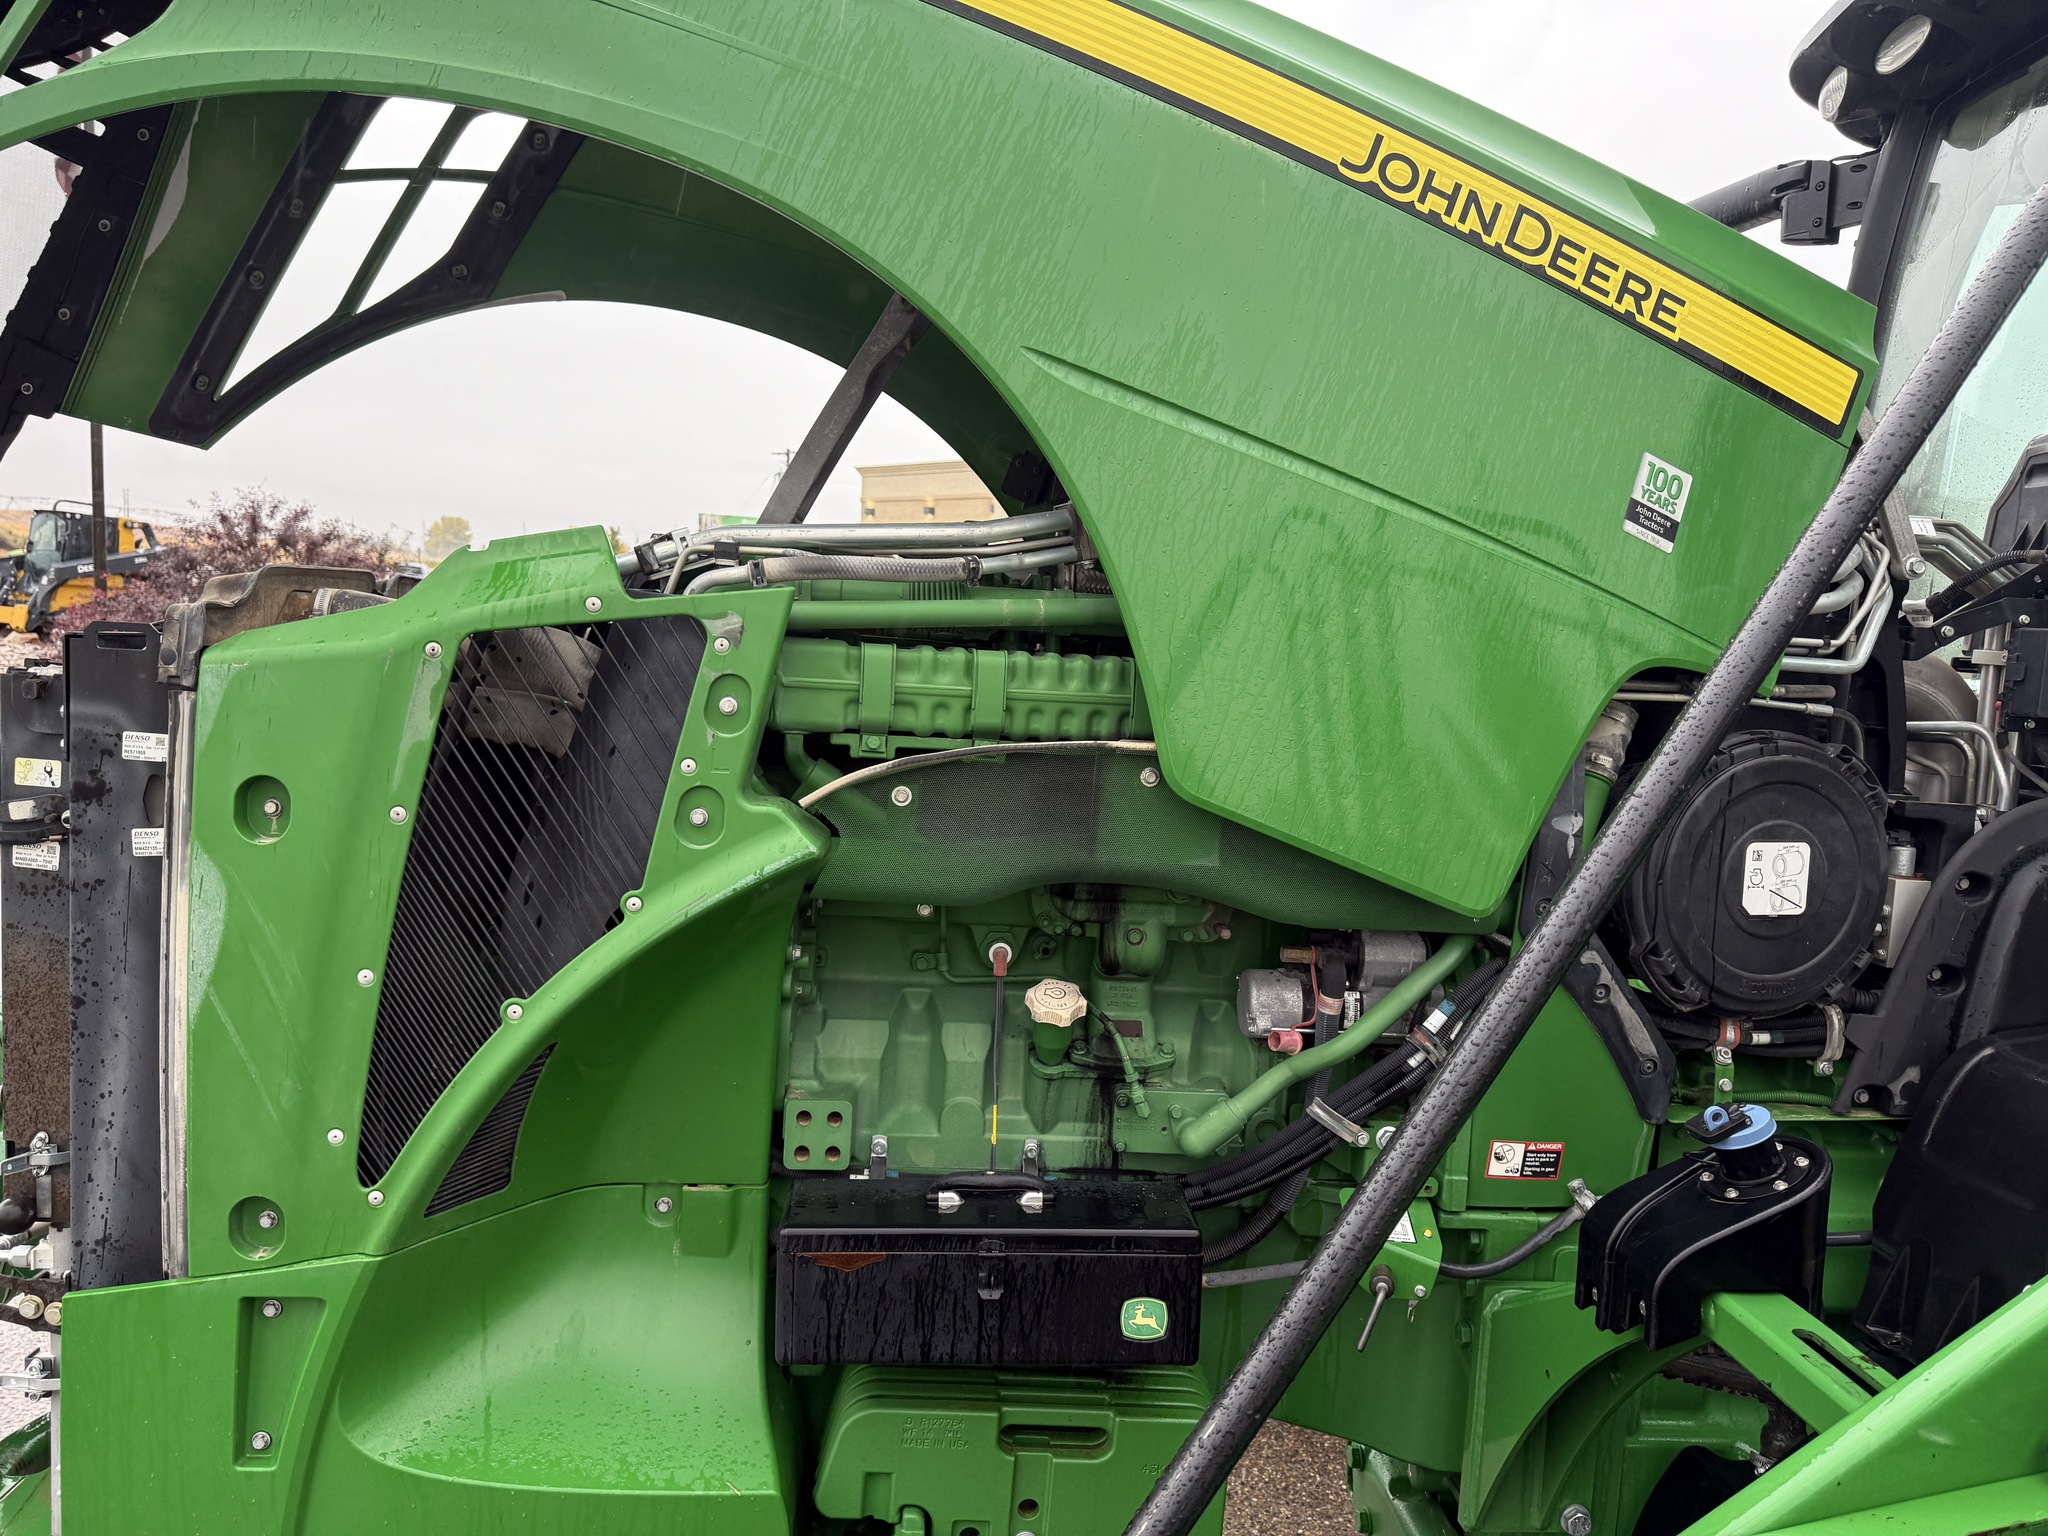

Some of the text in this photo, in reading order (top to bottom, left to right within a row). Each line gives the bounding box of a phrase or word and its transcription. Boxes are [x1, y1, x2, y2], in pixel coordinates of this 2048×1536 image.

[1339, 132, 1687, 334] JOHN DEERE
[1646, 461, 1684, 500] 100
[1641, 485, 1678, 514] YEARS
[1635, 504, 1672, 528] John Deere
[1639, 514, 1664, 534] Tractors
[77, 564, 95, 574] DEE
[901, 1438, 969, 1450] MADE IN USA
[1142, 1464, 1166, 1475] 43K
